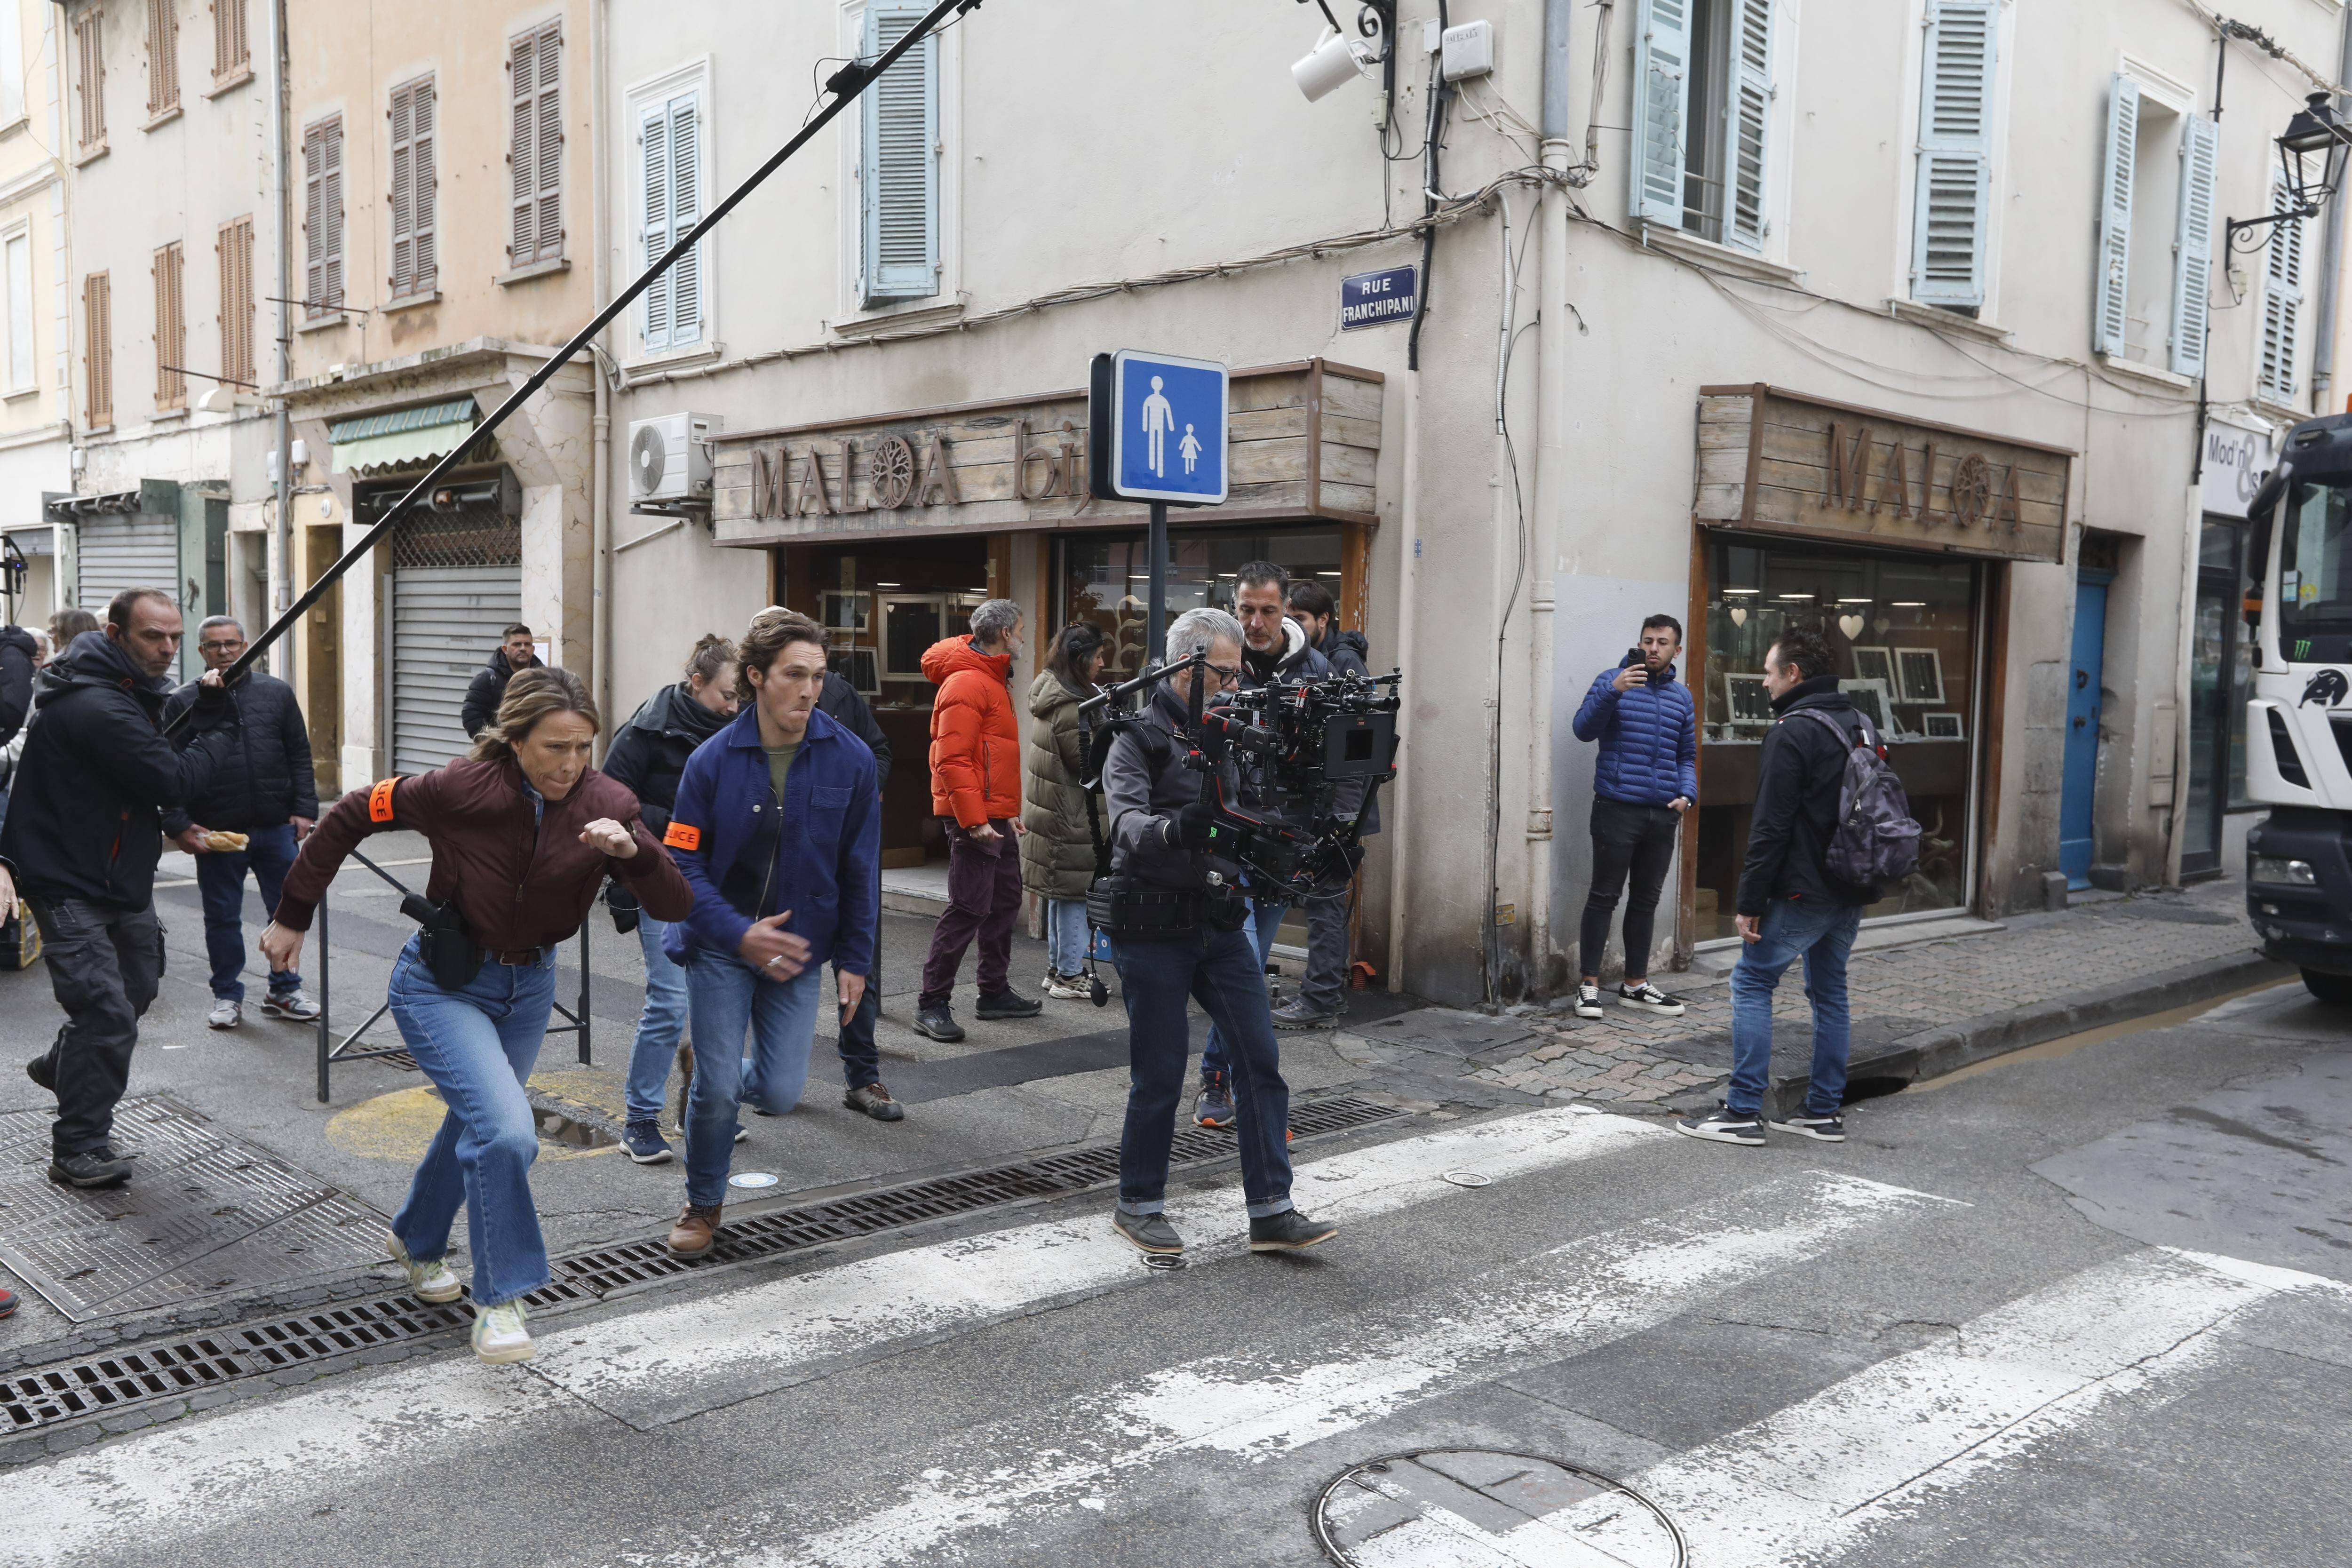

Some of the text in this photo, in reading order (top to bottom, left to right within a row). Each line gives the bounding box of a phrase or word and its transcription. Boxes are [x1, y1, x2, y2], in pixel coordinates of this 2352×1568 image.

[1362, 278, 1391, 295] RUE
[1343, 295, 1414, 322] FRANCHIPANI
[1011, 417, 1091, 516] bij
[376, 782, 389, 817] LICE
